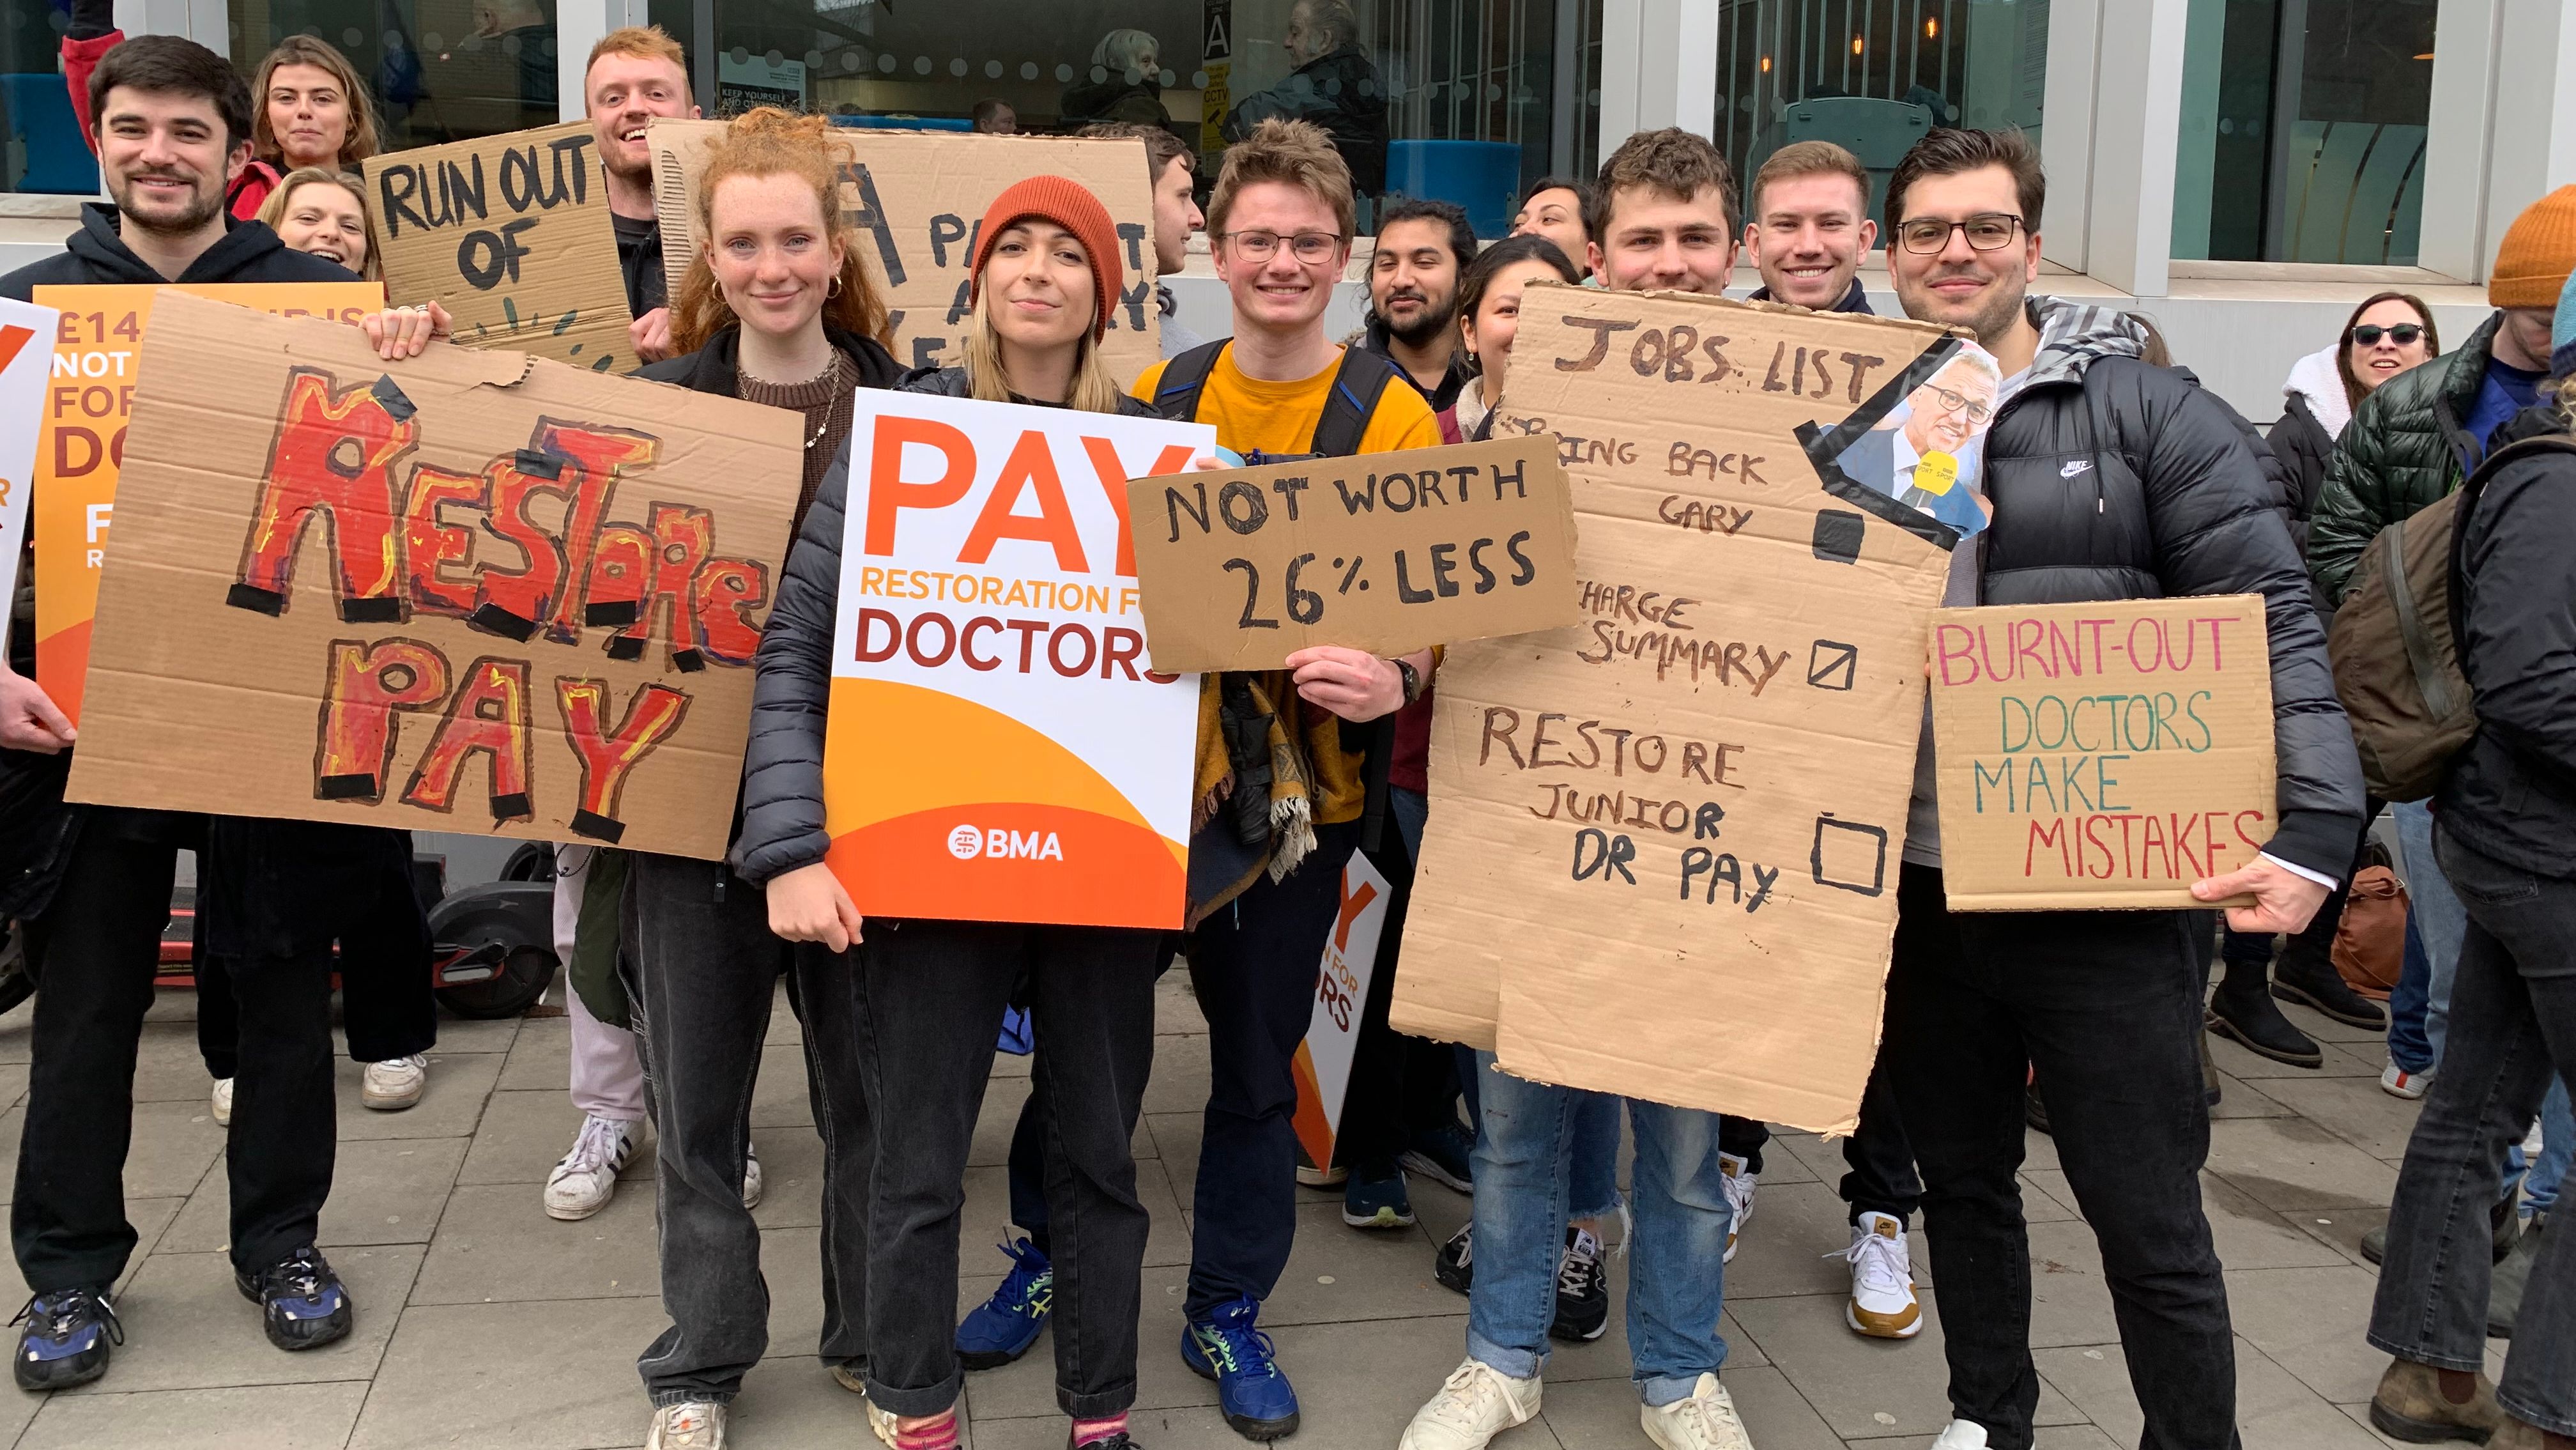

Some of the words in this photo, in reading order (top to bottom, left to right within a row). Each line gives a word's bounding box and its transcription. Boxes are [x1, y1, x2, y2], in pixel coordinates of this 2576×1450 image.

[1205, 15, 1229, 57] A
[722, 88, 742, 97] KEEP
[744, 90, 786, 102] YOURSELF
[1204, 89, 1228, 103] CCTV
[381, 153, 488, 240] RUN
[500, 135, 594, 213] OUT
[457, 217, 540, 291] OF
[53, 351, 132, 378] NOT
[1761, 341, 1884, 404] LIST
[1669, 440, 1768, 486] BACK
[2066, 460, 2088, 471] NIKE
[864, 414, 1196, 577] PAY
[1165, 477, 1309, 543] NOT
[1334, 459, 1528, 516] WORTH
[1659, 495, 1754, 536] GARY
[861, 567, 1109, 614] RESTORATION
[1223, 552, 1369, 629] 26%
[1395, 530, 1535, 604] LESS
[1577, 620, 1792, 697] SUMMARY
[1936, 617, 2241, 686] BURNT-OUT
[313, 636, 693, 844] PAY
[1480, 706, 1747, 791] RESTORE
[2001, 690, 2212, 753] DOCTORS
[1529, 783, 1725, 840] JUNIOR
[1975, 755, 2131, 814] MAKE
[986, 828, 1064, 861] BMA
[1572, 829, 1637, 885] DR
[1680, 847, 1779, 913] PAY
[1331, 953, 1359, 998] FOR
